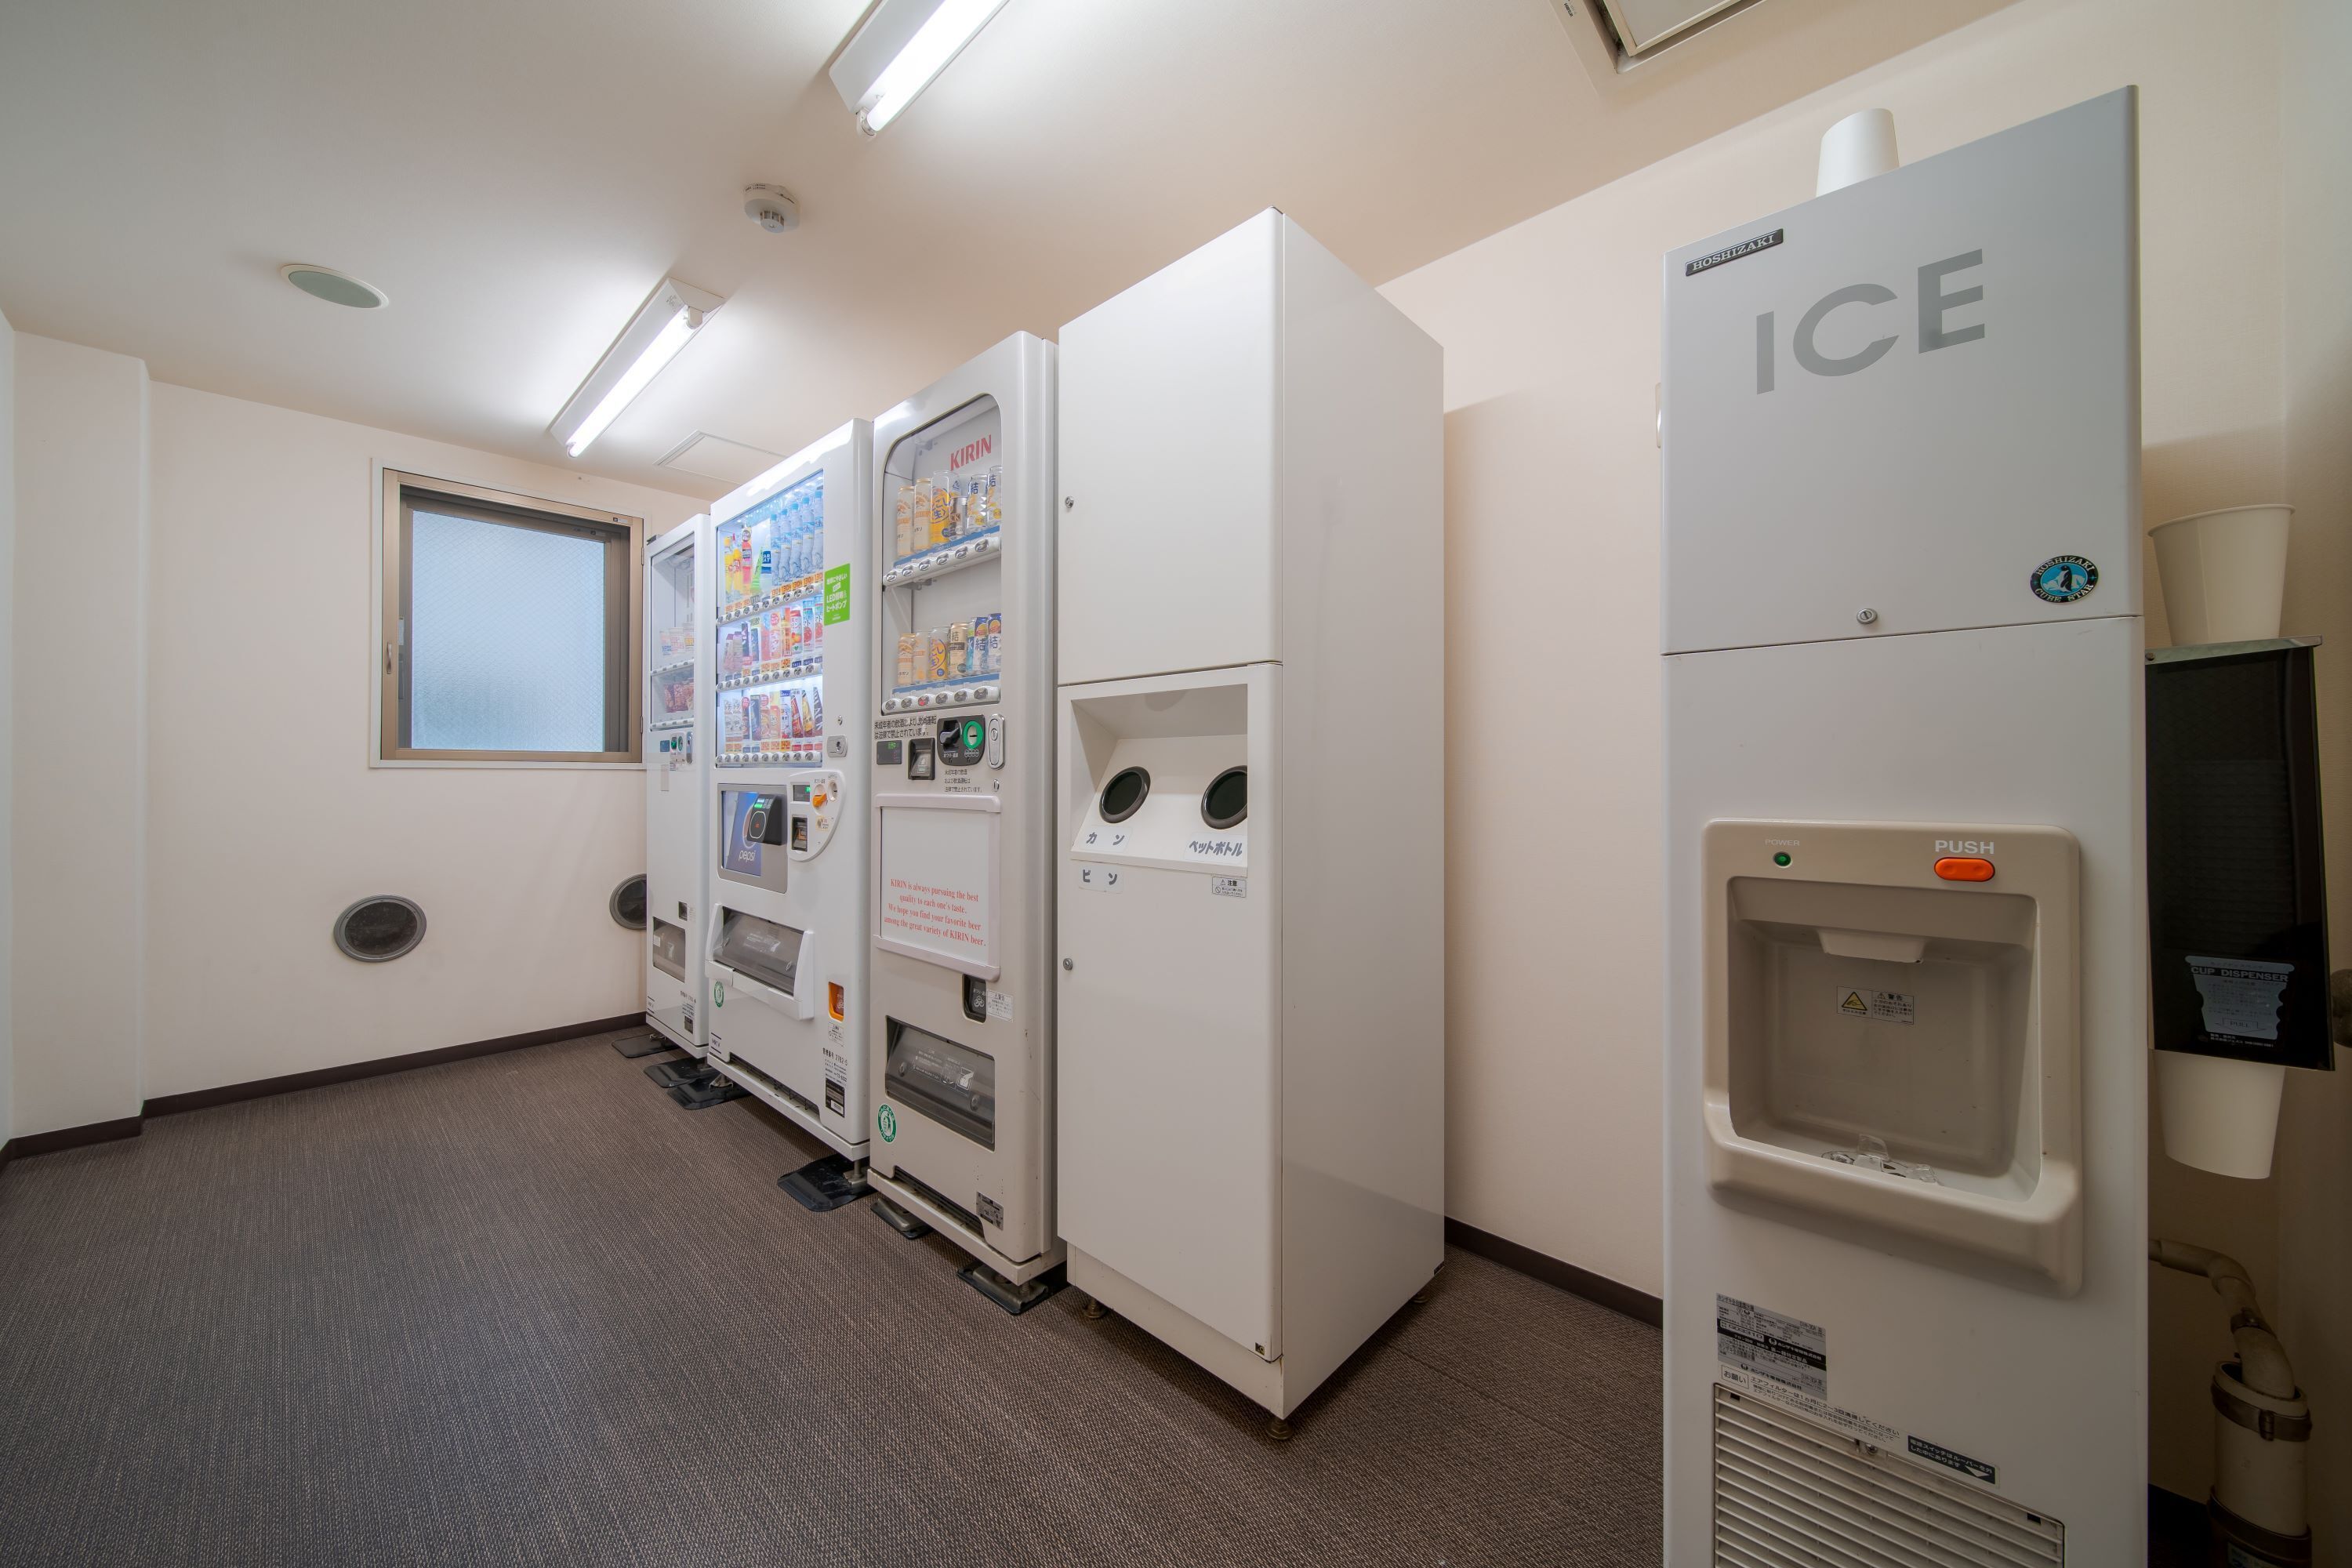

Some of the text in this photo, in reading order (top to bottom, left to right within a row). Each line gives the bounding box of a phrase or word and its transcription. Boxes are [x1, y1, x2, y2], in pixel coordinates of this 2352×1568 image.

[1692, 234, 1775, 273] HOSHIZAKI
[1756, 248, 1985, 395] ICE
[949, 434, 992, 470] KIRIN
[2035, 556, 2095, 575] HOSHIZAKI
[2034, 584, 2094, 602] CUBE STAR
[1765, 838, 1800, 847] POWER
[1934, 840, 1995, 855] PUSH
[738, 849, 757, 863] pepsi
[891, 878, 978, 902] KIRIN is always pursuing the best
[899, 894, 967, 914] quality to each one's taste.
[888, 902, 981, 931] We hope you find your favorite beer
[884, 916, 899, 929] among
[909, 921, 923, 933] great
[924, 922, 941, 937] variety
[942, 926, 949, 937] of
[949, 928, 969, 942] KIRIN
[970, 932, 986, 946] beer.
[2190, 966, 2288, 982] CUP DISPENSER
[1723, 1370, 1747, 1385] お願い
[1910, 1439, 1993, 1474] 電源スイッチはルーバーを外
[1911, 1445, 1961, 1468] した中にあります
